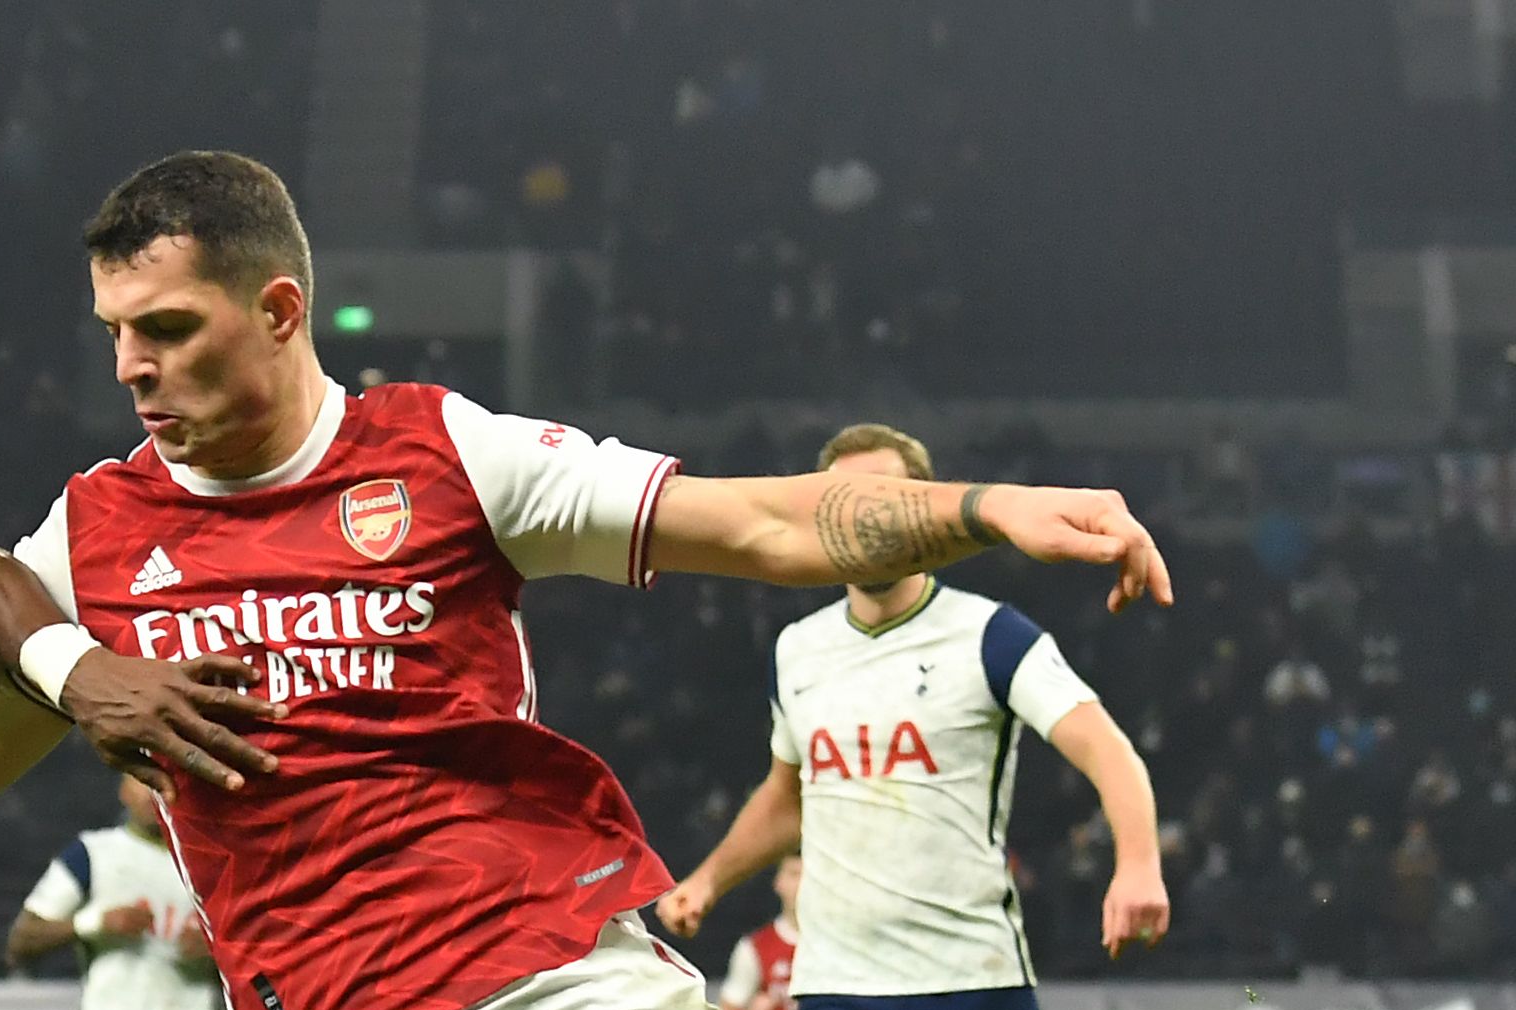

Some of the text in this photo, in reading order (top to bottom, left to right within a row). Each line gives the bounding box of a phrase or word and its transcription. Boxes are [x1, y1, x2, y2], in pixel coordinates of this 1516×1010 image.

[129, 569, 182, 596] adidas
[132, 582, 434, 662] Emirates
[266, 645, 395, 703] BETTER
[807, 720, 938, 784] AIA
